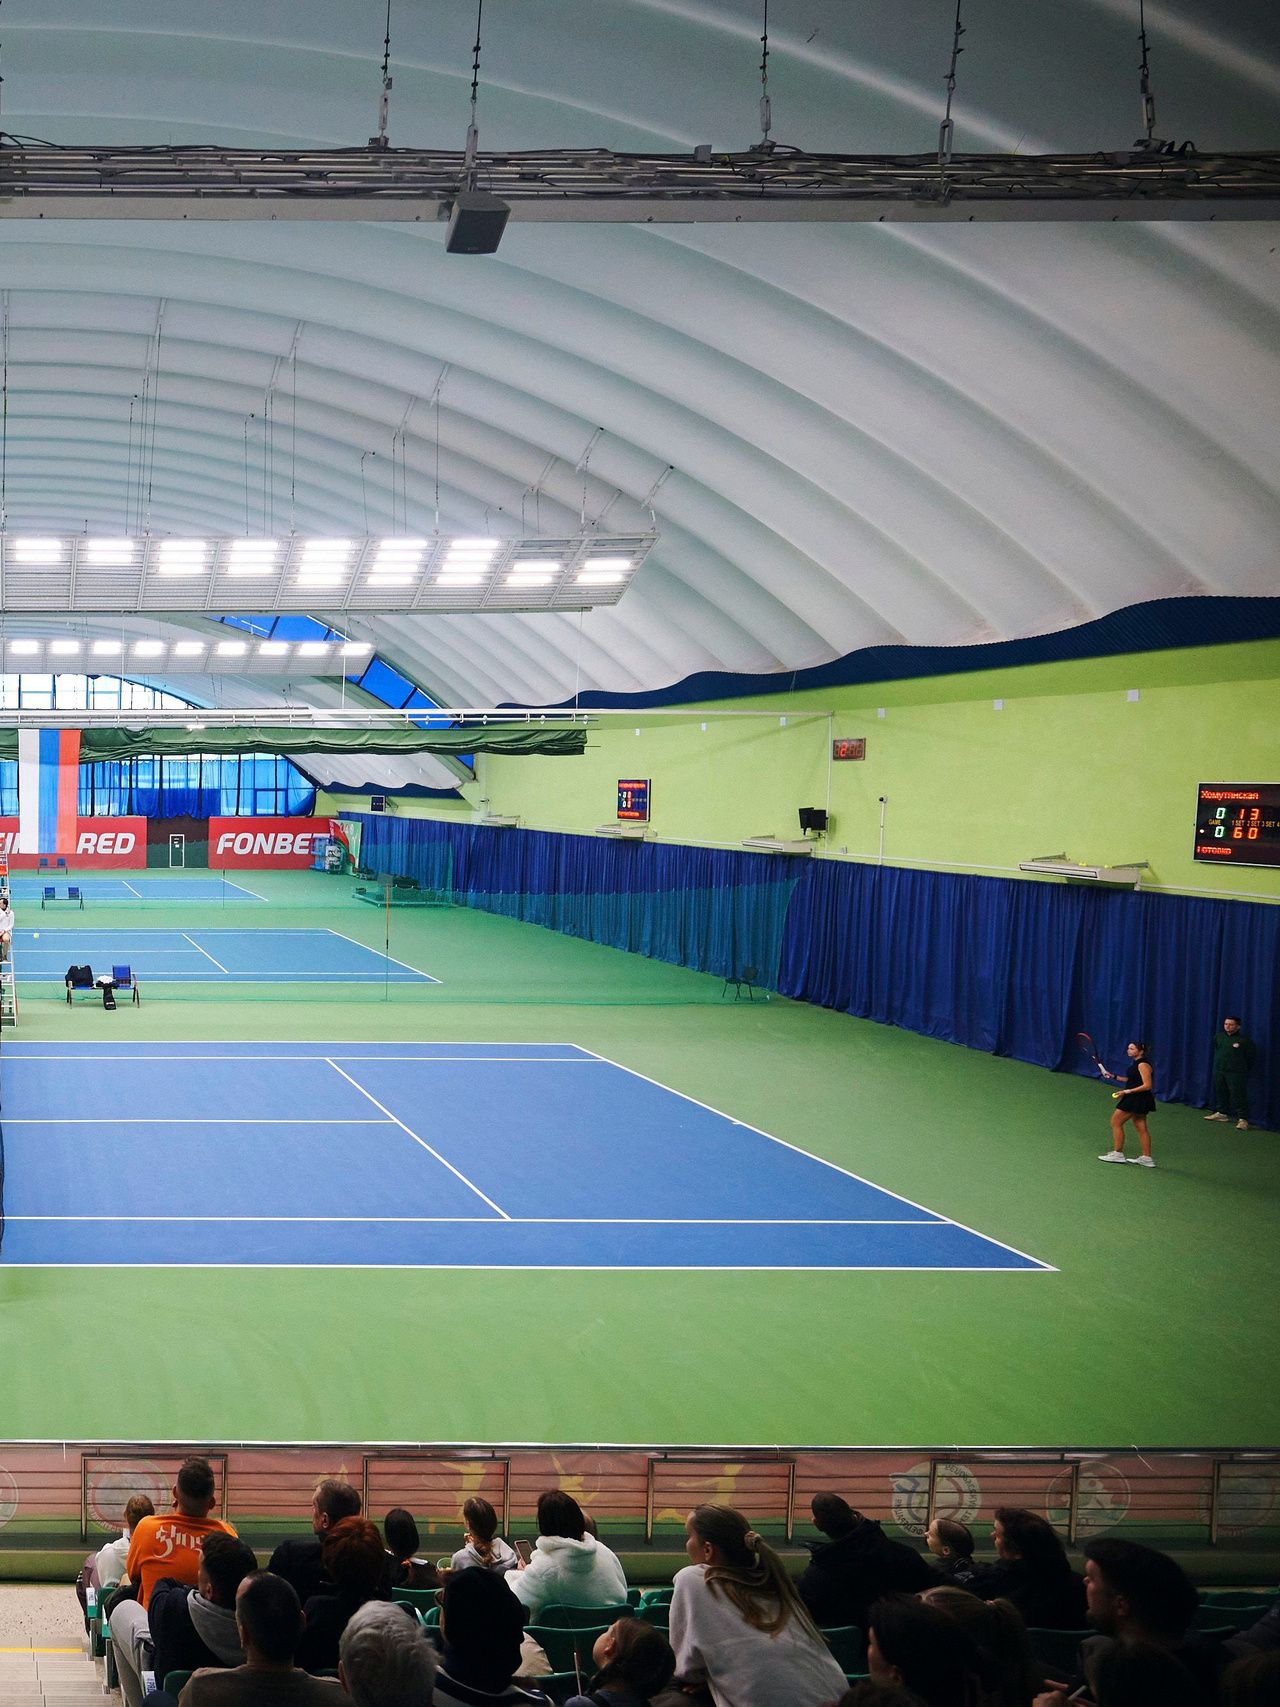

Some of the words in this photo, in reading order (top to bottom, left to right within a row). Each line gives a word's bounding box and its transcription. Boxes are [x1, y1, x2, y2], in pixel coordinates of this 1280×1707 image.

[1216, 807, 1226, 819] 0
[1214, 826, 1224, 838] 0
[76, 832, 136, 855] RED
